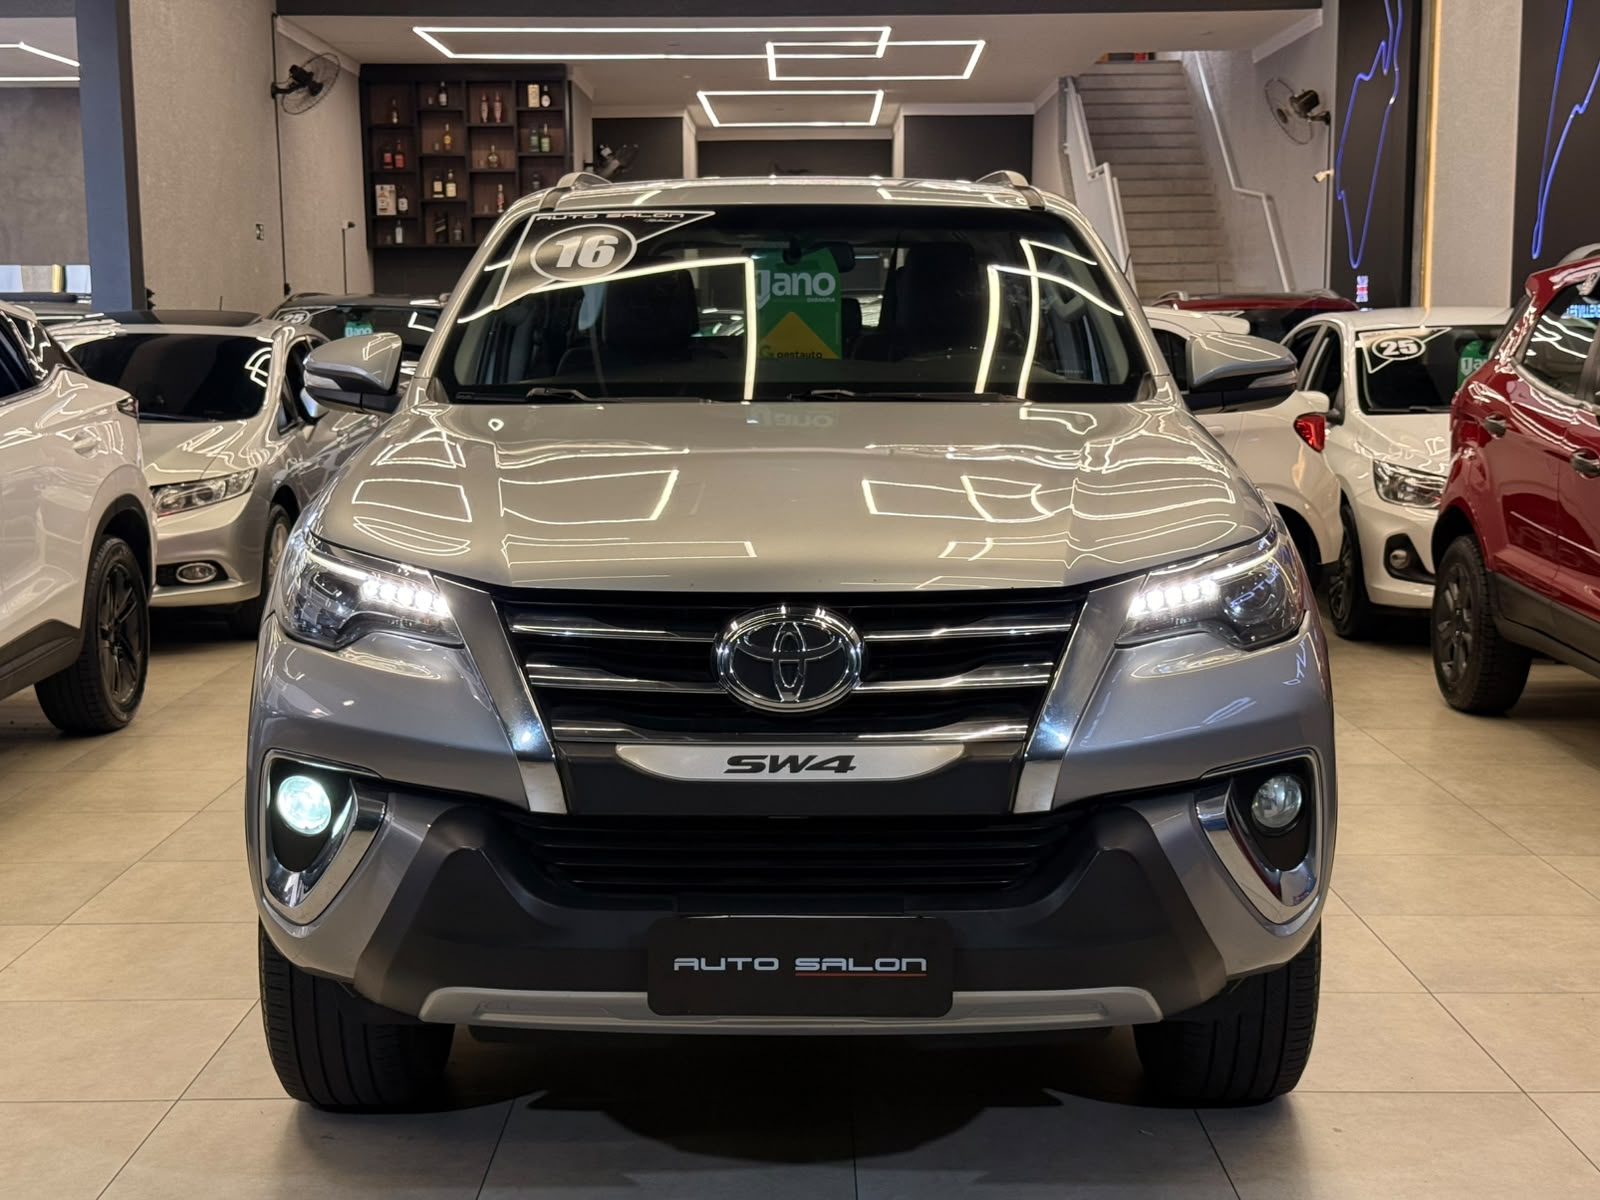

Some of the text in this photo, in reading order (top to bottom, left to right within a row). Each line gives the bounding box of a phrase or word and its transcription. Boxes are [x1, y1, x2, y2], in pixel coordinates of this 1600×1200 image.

[535, 213, 599, 221] AUTO
[555, 234, 619, 268] 16
[1379, 340, 1419, 356] 25
[723, 754, 857, 774] SW4
[673, 957, 928, 972] AUTO SALON
